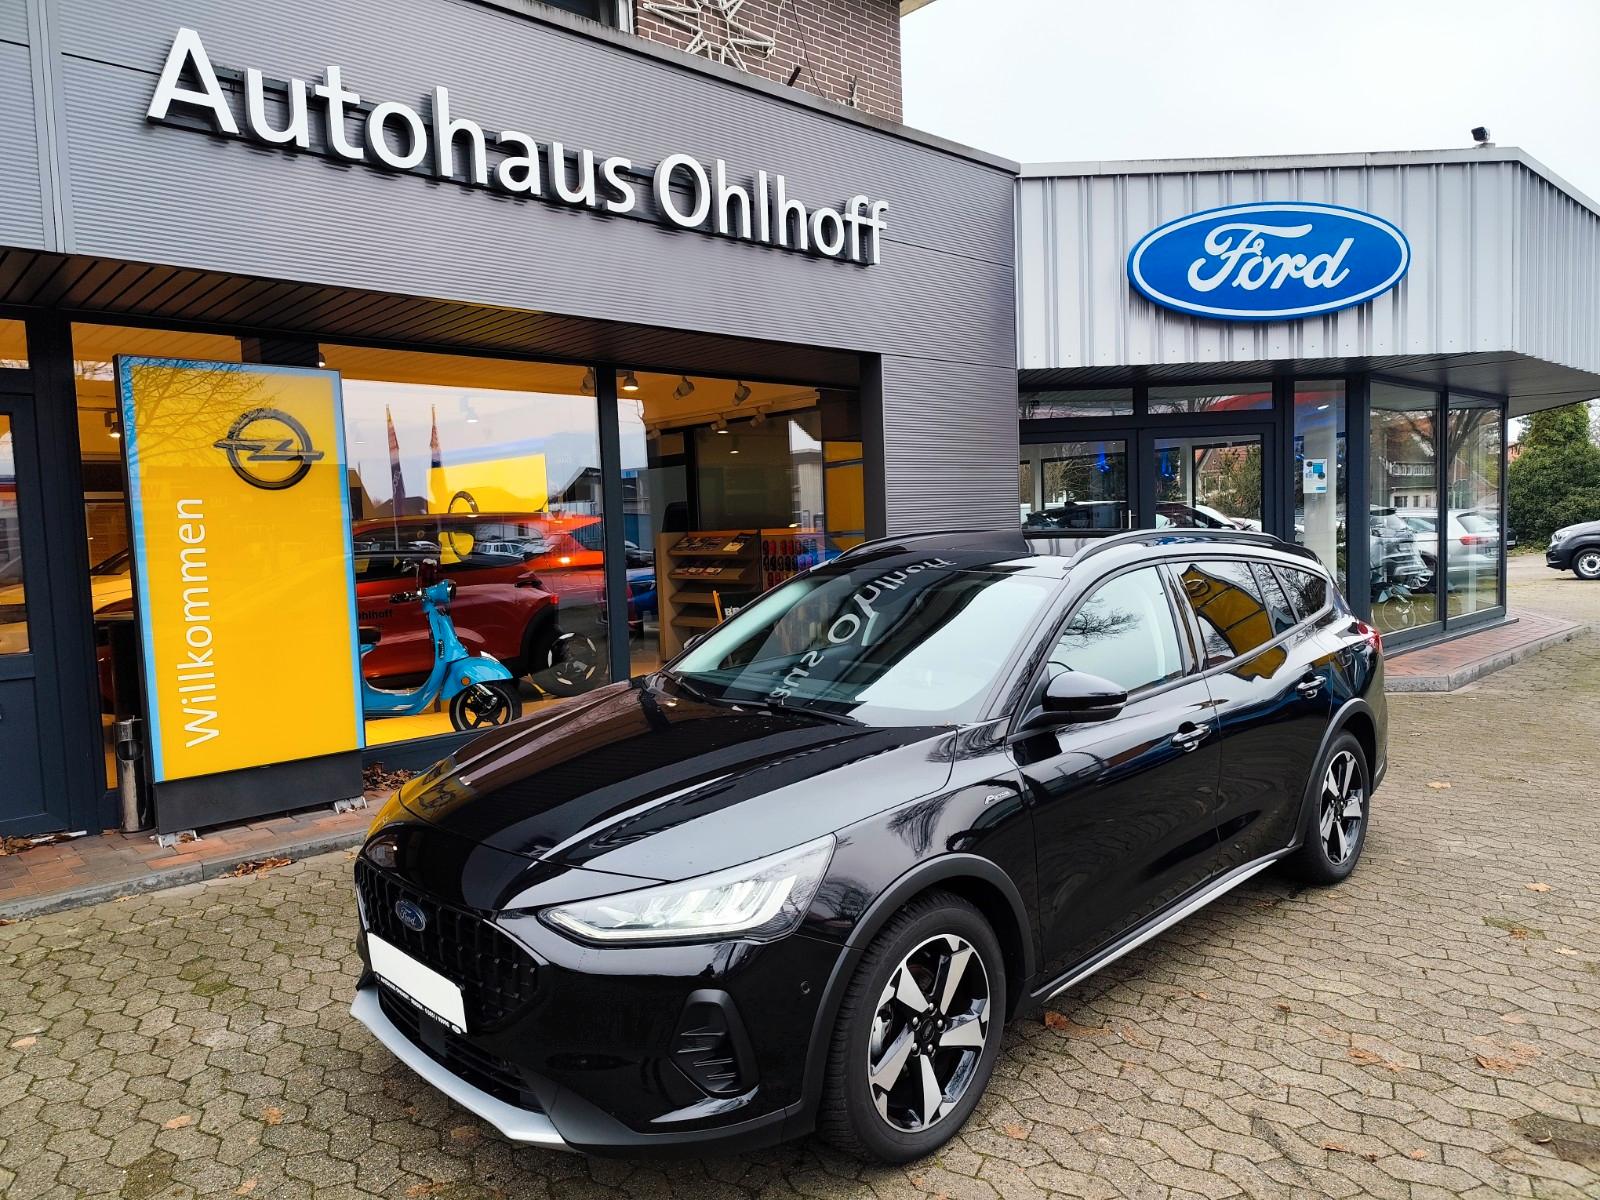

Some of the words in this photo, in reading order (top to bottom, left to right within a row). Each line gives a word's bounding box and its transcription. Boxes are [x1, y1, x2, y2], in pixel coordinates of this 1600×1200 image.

[146, 27, 635, 213] Autohaus
[654, 153, 889, 264] Ohlhoff
[1187, 222, 1355, 292] Ford
[176, 498, 220, 748] Willkommen
